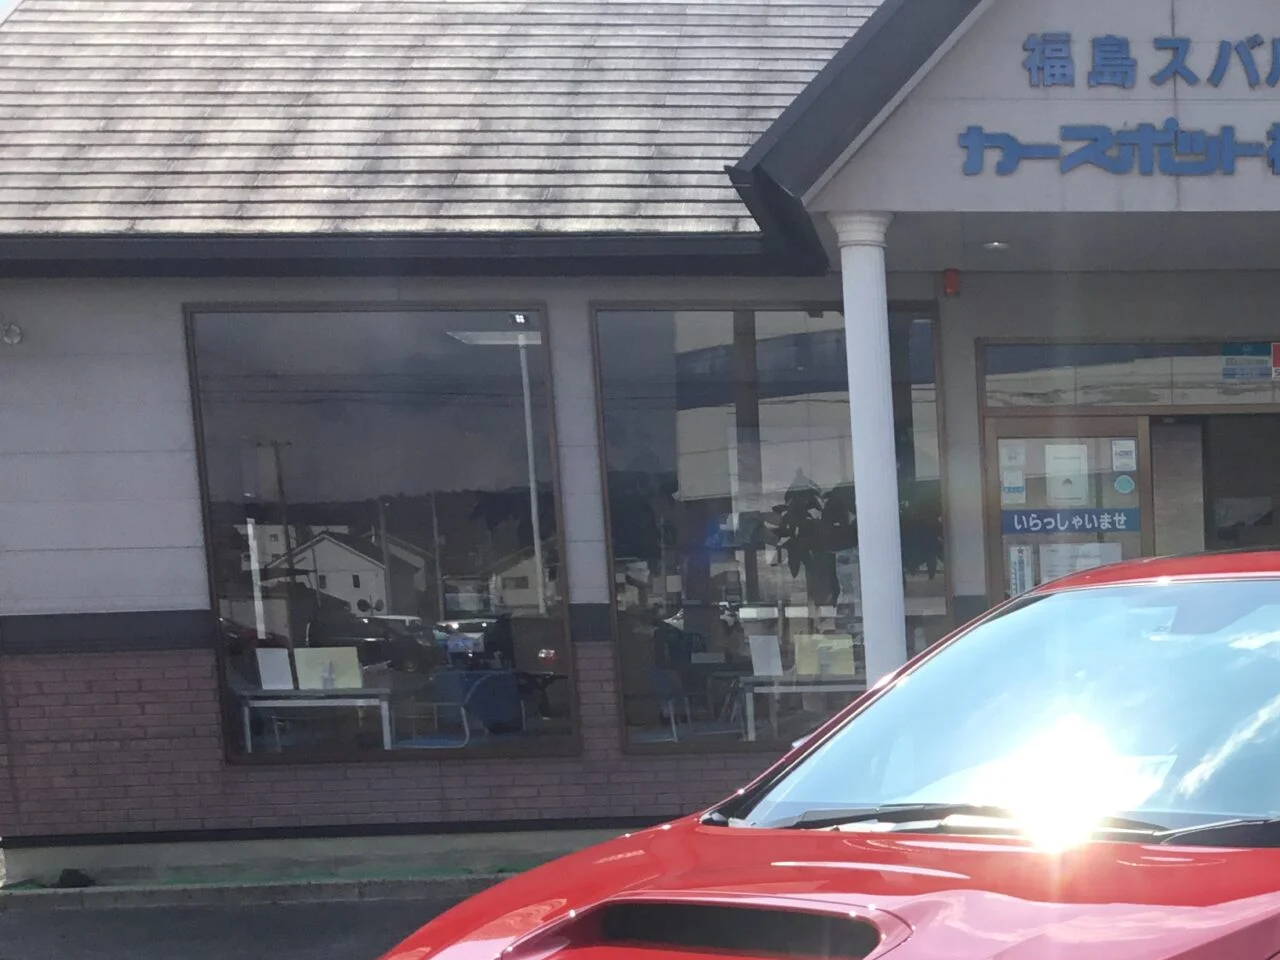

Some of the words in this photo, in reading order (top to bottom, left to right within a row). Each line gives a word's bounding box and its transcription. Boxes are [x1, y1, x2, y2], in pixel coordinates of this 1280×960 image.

[461, 375, 572, 417] SUBARU
[1013, 512, 1127, 531] いらっしゃいませ
